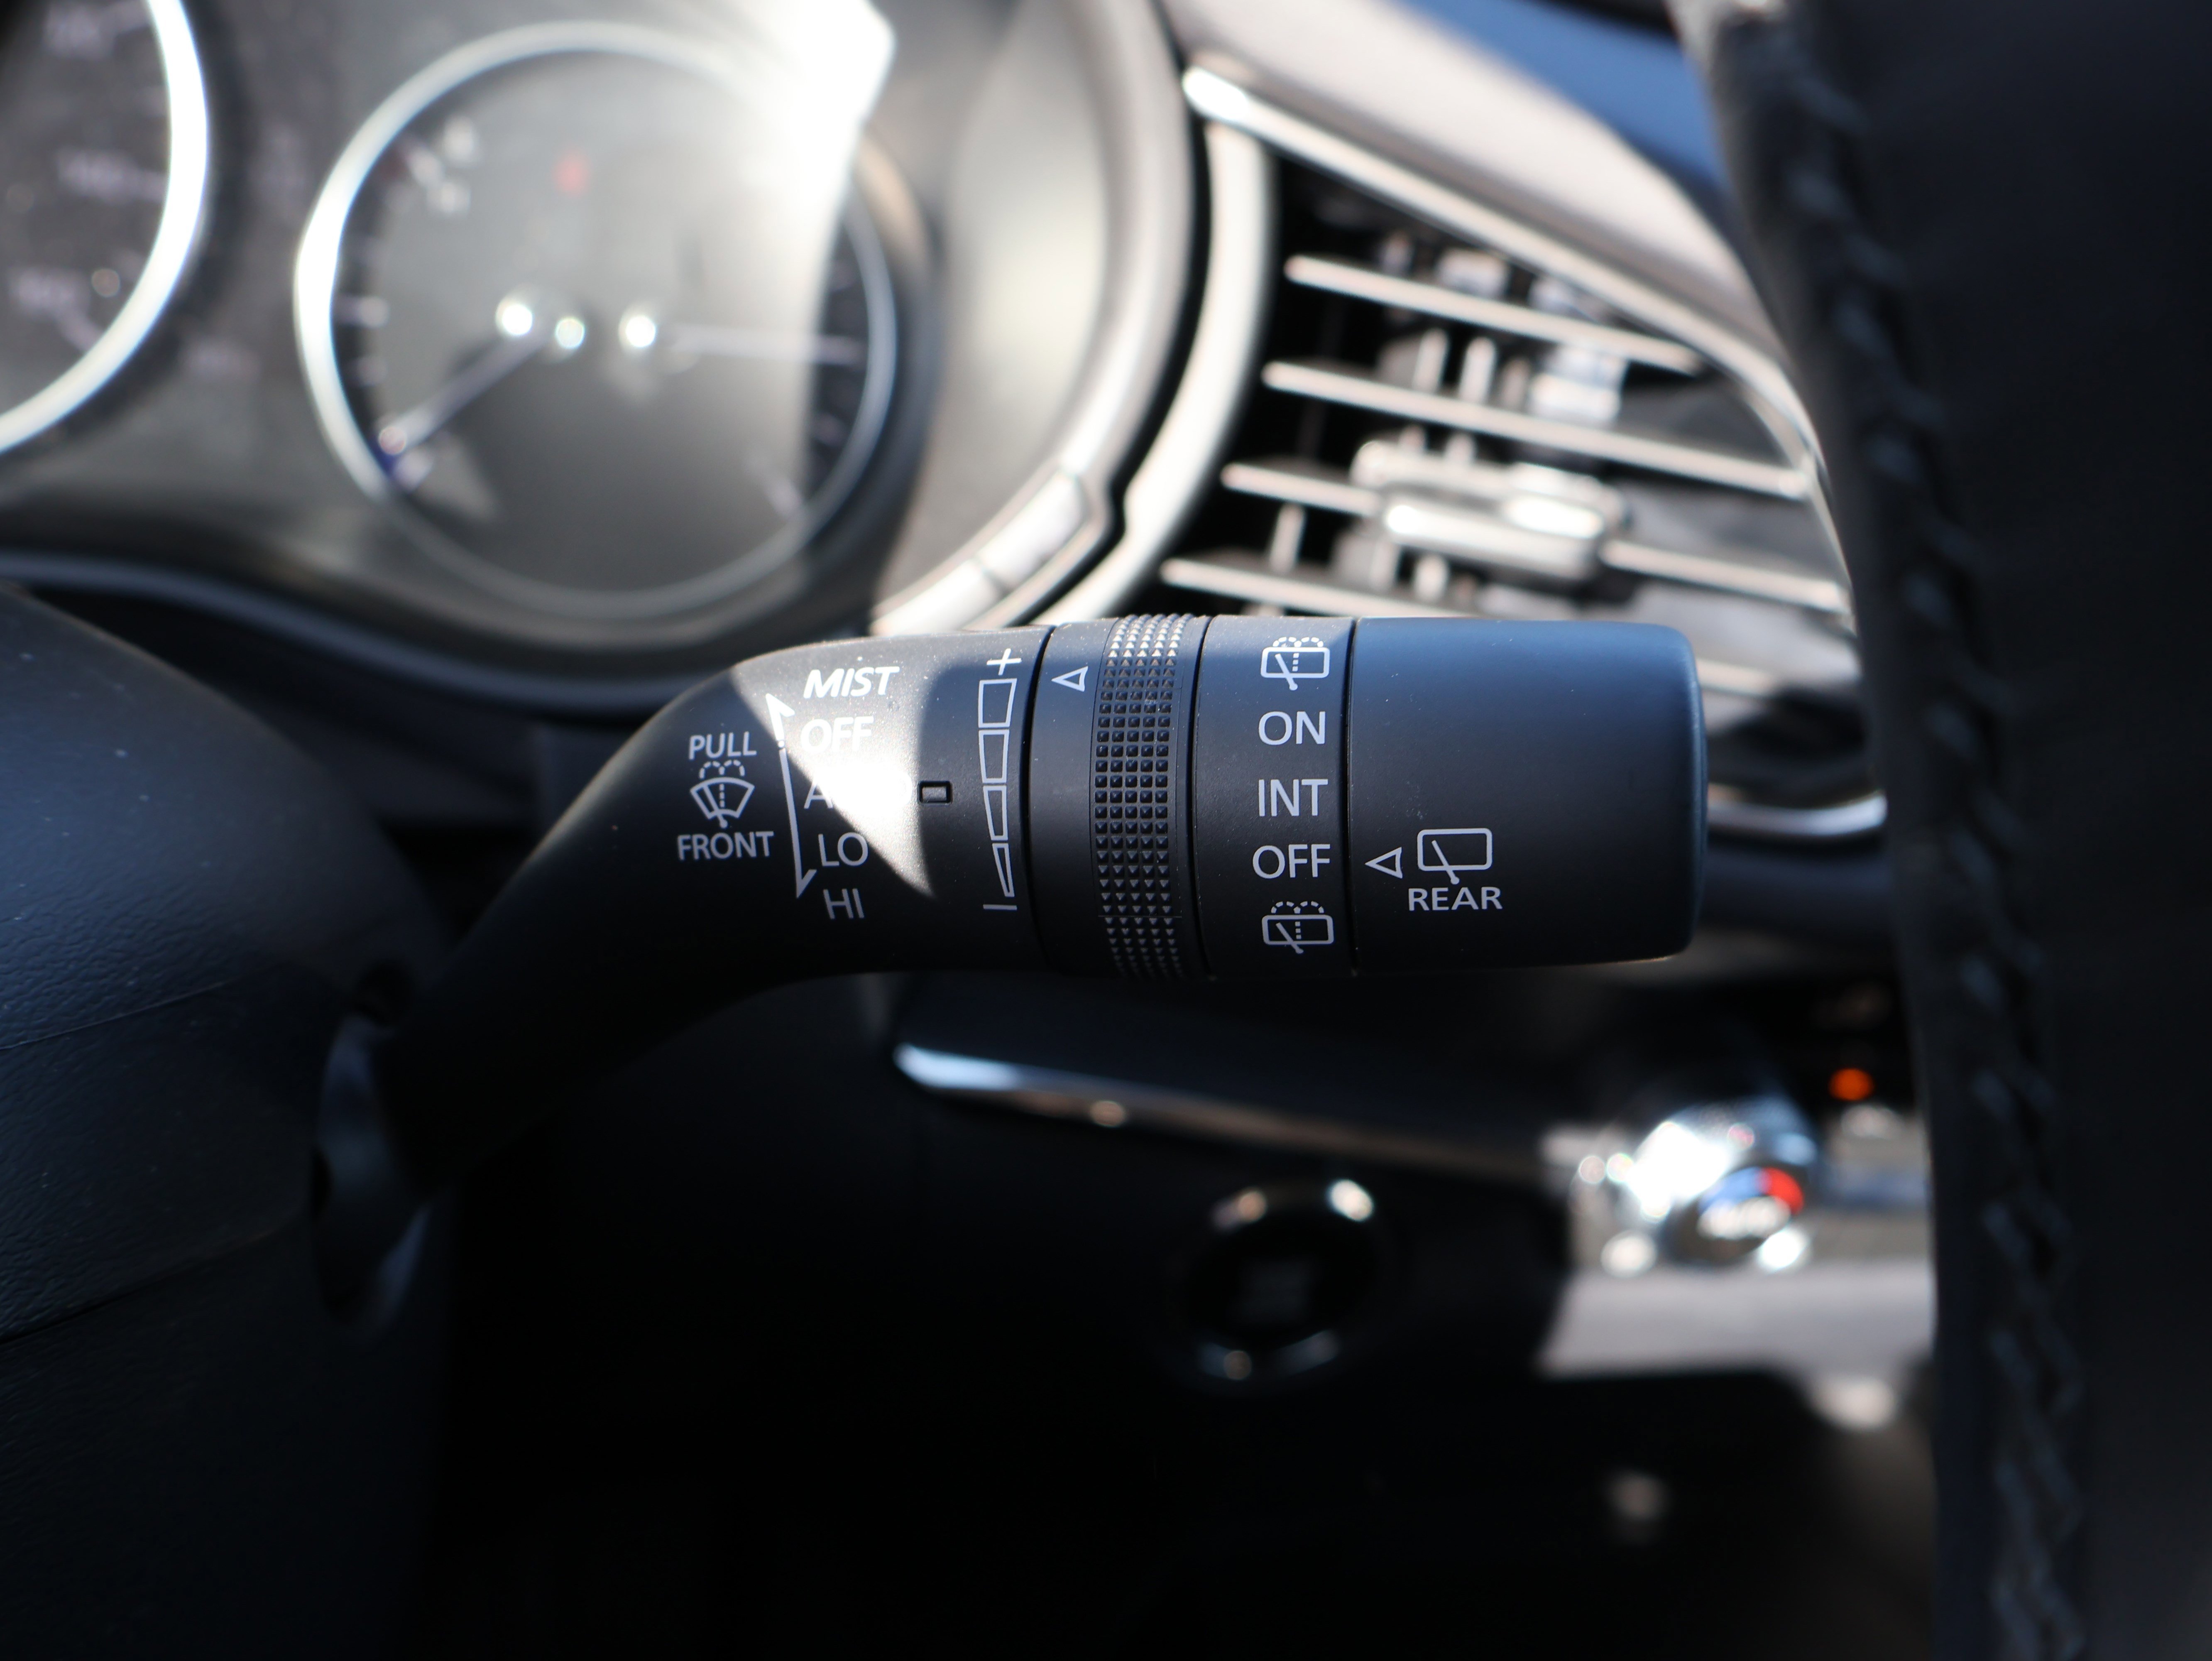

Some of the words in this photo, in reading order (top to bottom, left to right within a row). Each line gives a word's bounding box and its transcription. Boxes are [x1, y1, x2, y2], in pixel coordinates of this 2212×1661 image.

[803, 666, 900, 699] MIST
[800, 716, 874, 752] OFF
[1258, 711, 1326, 745] ON
[689, 732, 757, 759] PULL
[1258, 779, 1328, 816] INT
[678, 831, 774, 861] FRONT
[818, 832, 869, 867] LO
[1252, 844, 1331, 879] OFF
[823, 889, 864, 919] HI
[1408, 887, 1503, 911] REAR
